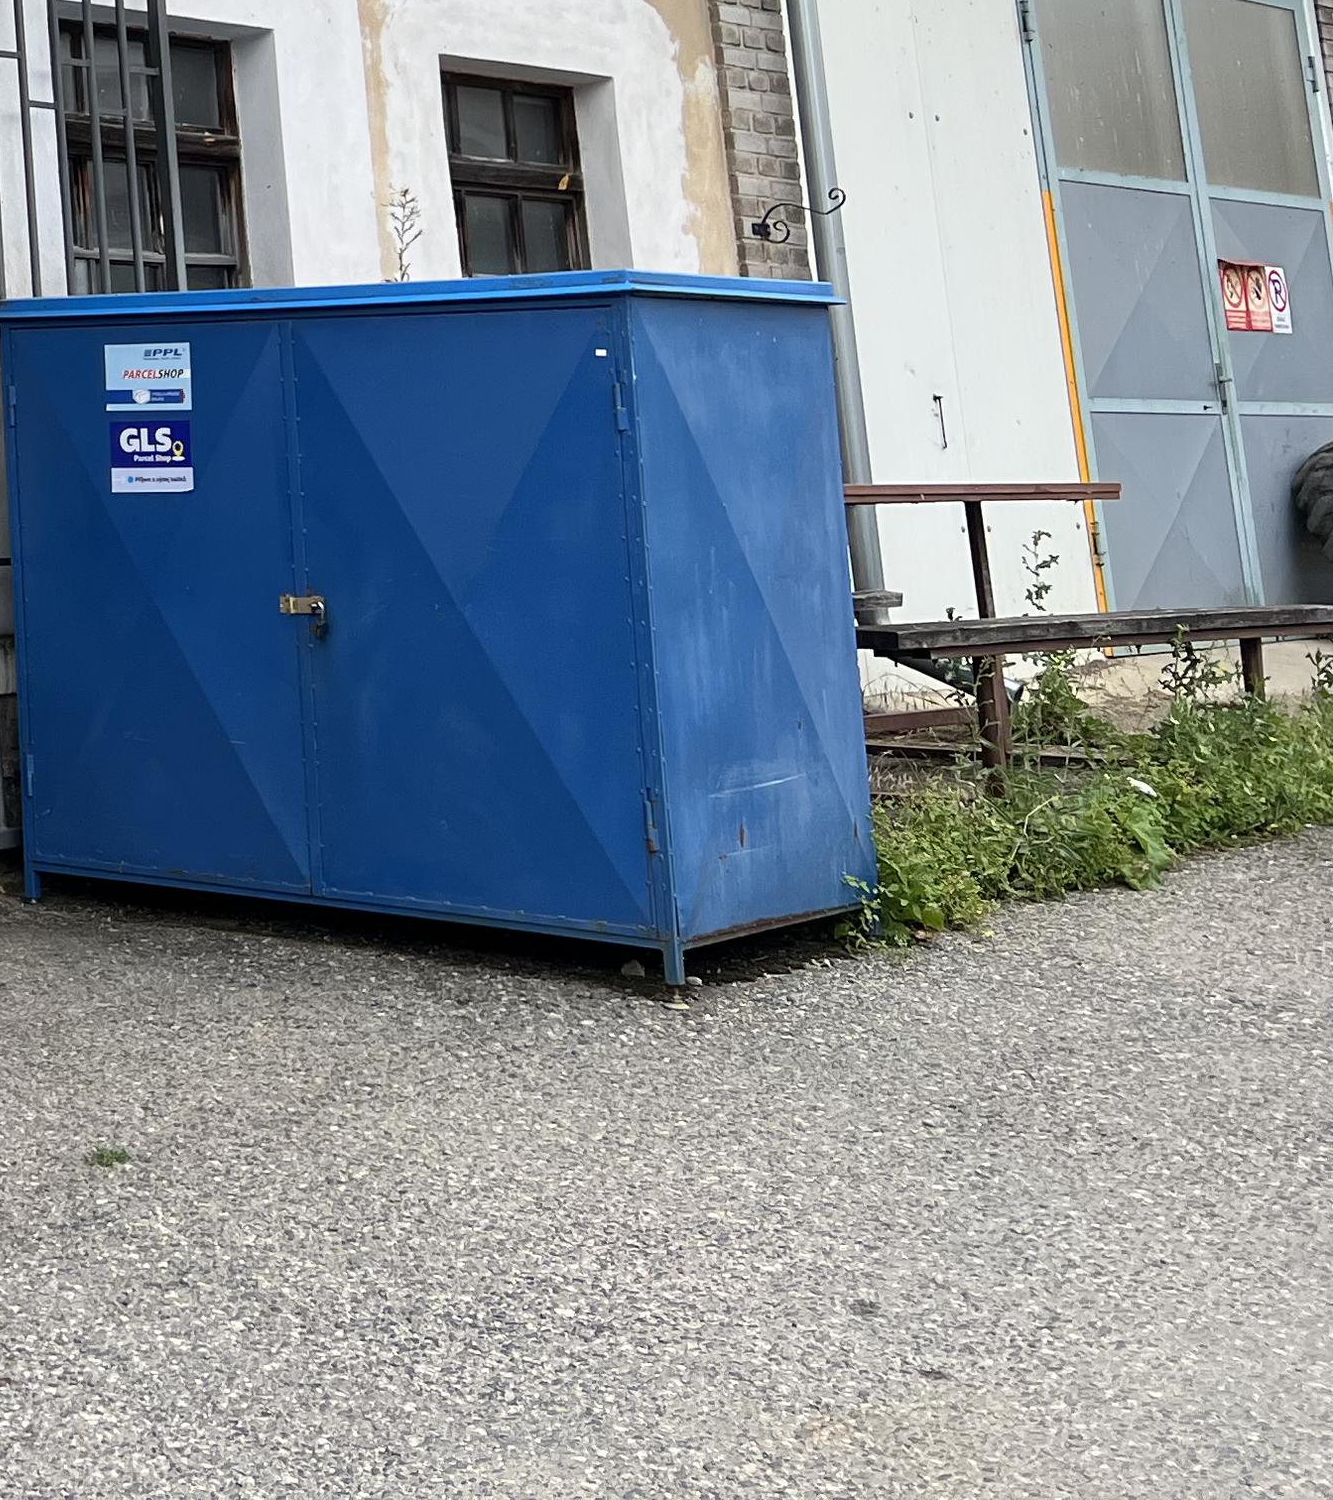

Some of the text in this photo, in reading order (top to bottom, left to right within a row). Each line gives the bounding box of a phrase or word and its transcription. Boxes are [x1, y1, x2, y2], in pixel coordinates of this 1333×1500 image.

[153, 348, 182, 357] PPL
[122, 368, 184, 379] PARCELSHOP
[119, 427, 172, 453] GLS
[133, 454, 154, 462] Parcel
